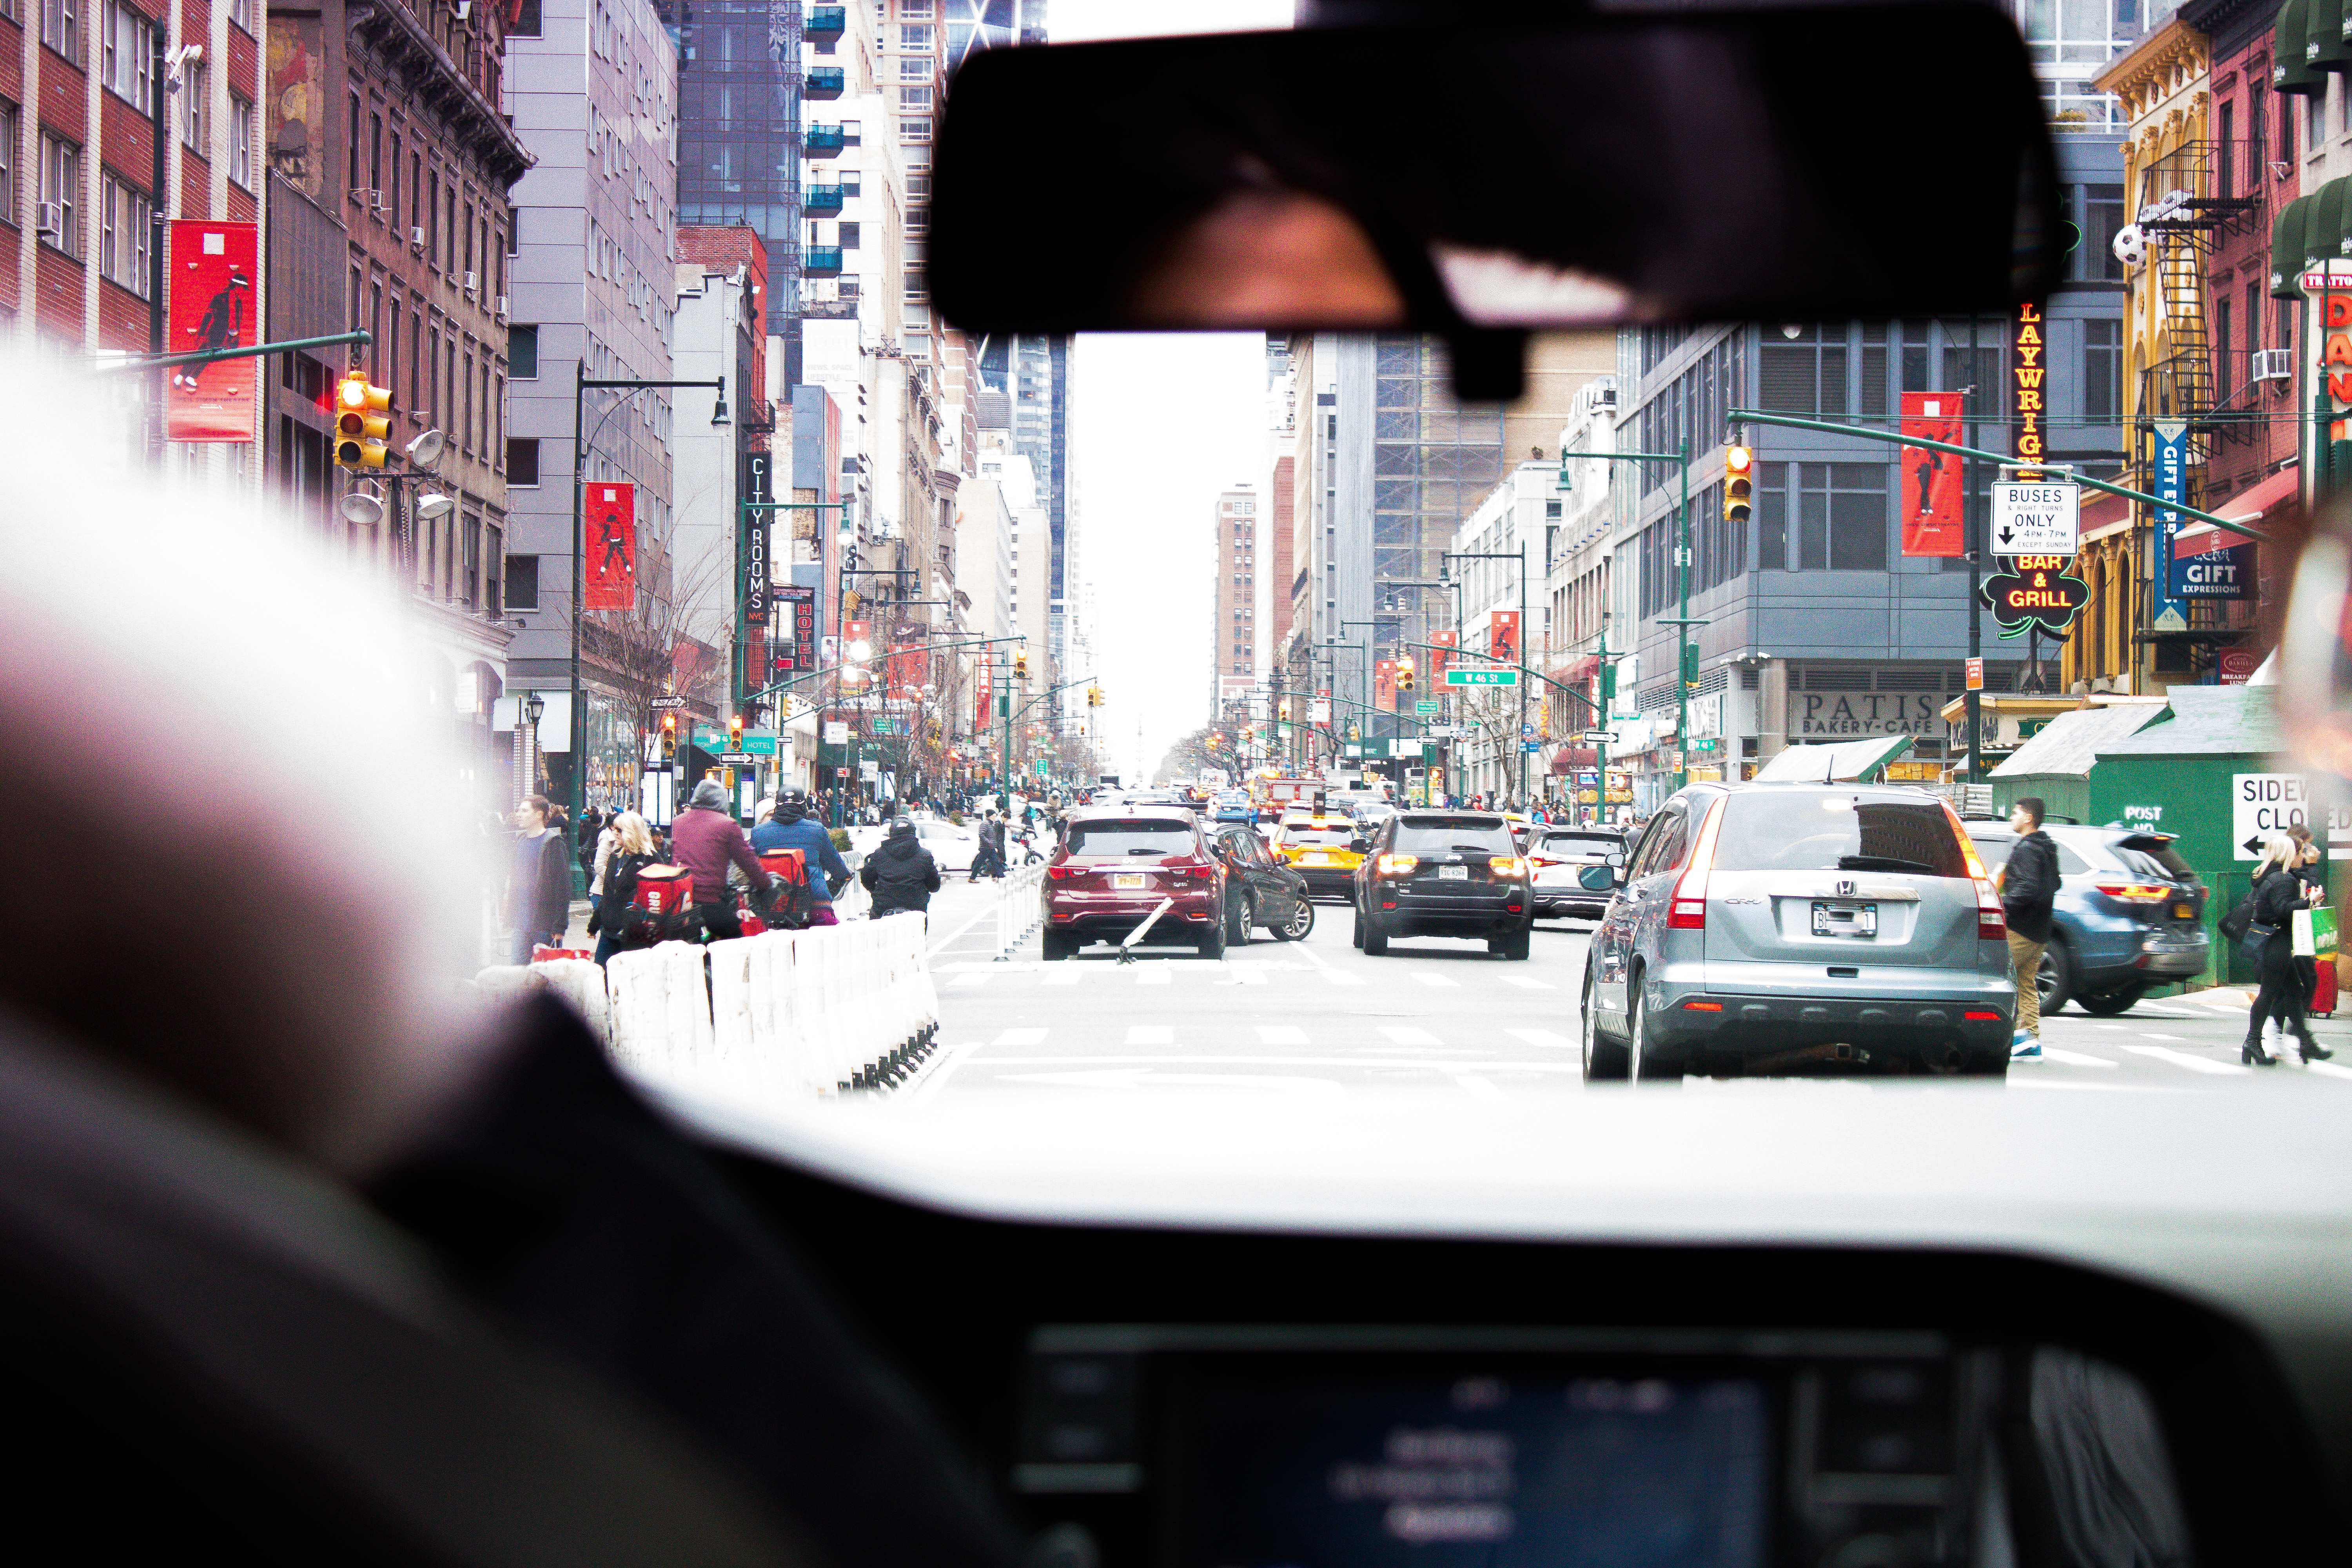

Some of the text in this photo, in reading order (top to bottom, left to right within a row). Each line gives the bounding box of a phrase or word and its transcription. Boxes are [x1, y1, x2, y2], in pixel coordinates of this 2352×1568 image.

[2163, 446, 2178, 485] GIFT
[752, 458, 763, 524] CITY
[2010, 490, 2062, 502] BUSES
[2015, 514, 2054, 527] ONLY
[750, 529, 763, 608] ROOMS
[2019, 556, 2062, 569] BAR
[2033, 573, 2046, 588] &
[2187, 565, 2237, 583] GIFT
[2182, 584, 2241, 593] EXPRESSIONS
[2009, 590, 2072, 607] GRILL
[748, 612, 764, 621] NYC
[797, 603, 812, 666] HOTEL
[1465, 673, 1499, 682] W 46 St
[1803, 695, 1932, 720] PATIS
[1701, 740, 1708, 749] 46
[1203, 775, 1223, 784] FedEx
[2126, 806, 2162, 820] POST
[2134, 823, 2154, 832] NO
